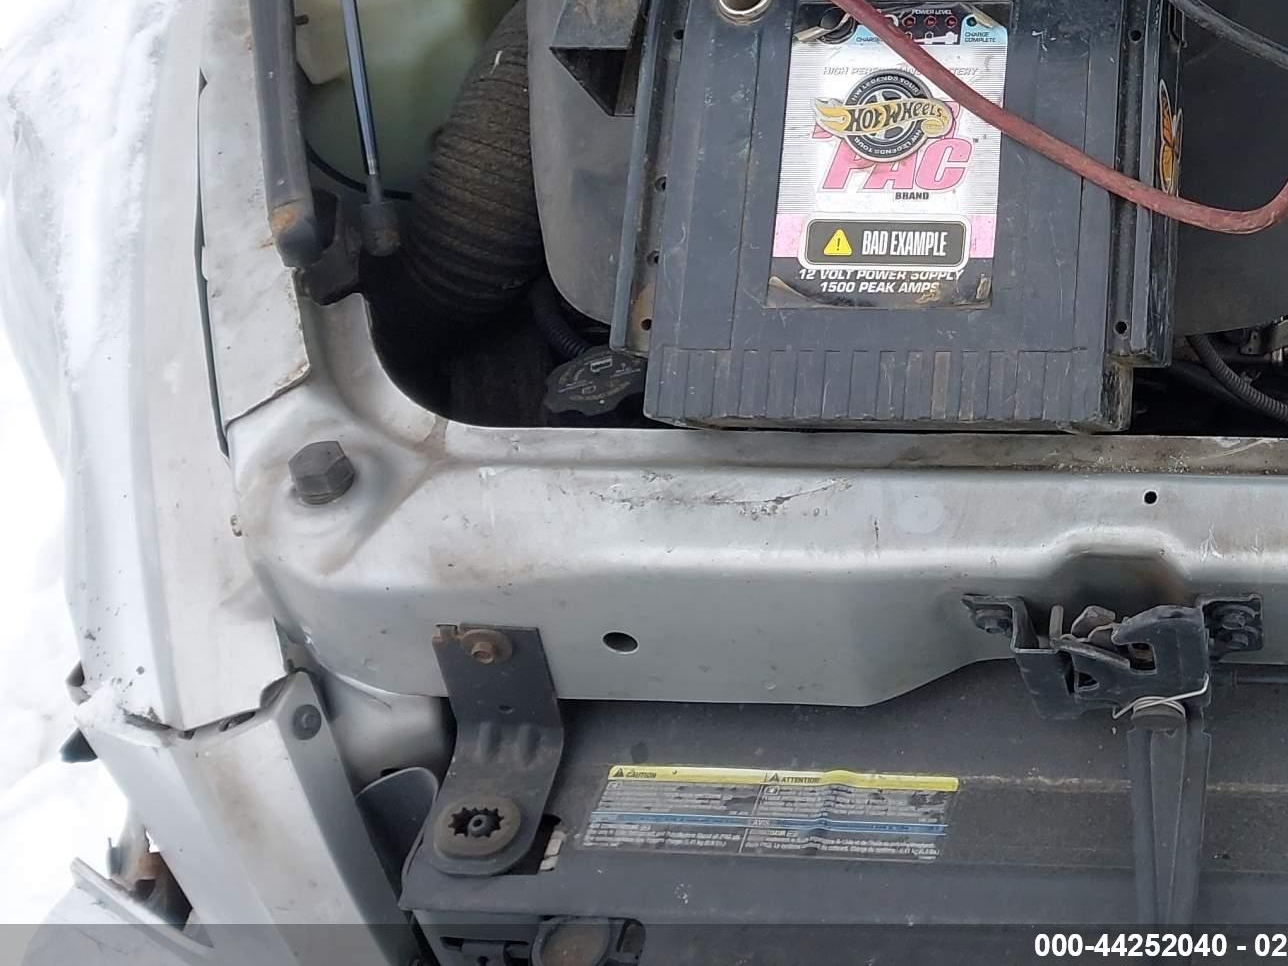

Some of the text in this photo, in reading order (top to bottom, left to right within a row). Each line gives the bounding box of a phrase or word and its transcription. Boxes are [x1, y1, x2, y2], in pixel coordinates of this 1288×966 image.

[895, 192, 929, 200] BRAND
[862, 230, 948, 256] BAD EXAMPLE
[799, 269, 963, 281] 12 VOLT POWER SUPPLY
[820, 282, 940, 293] 1500 PEAK AMPS
[625, 770, 657, 778] CAUTION
